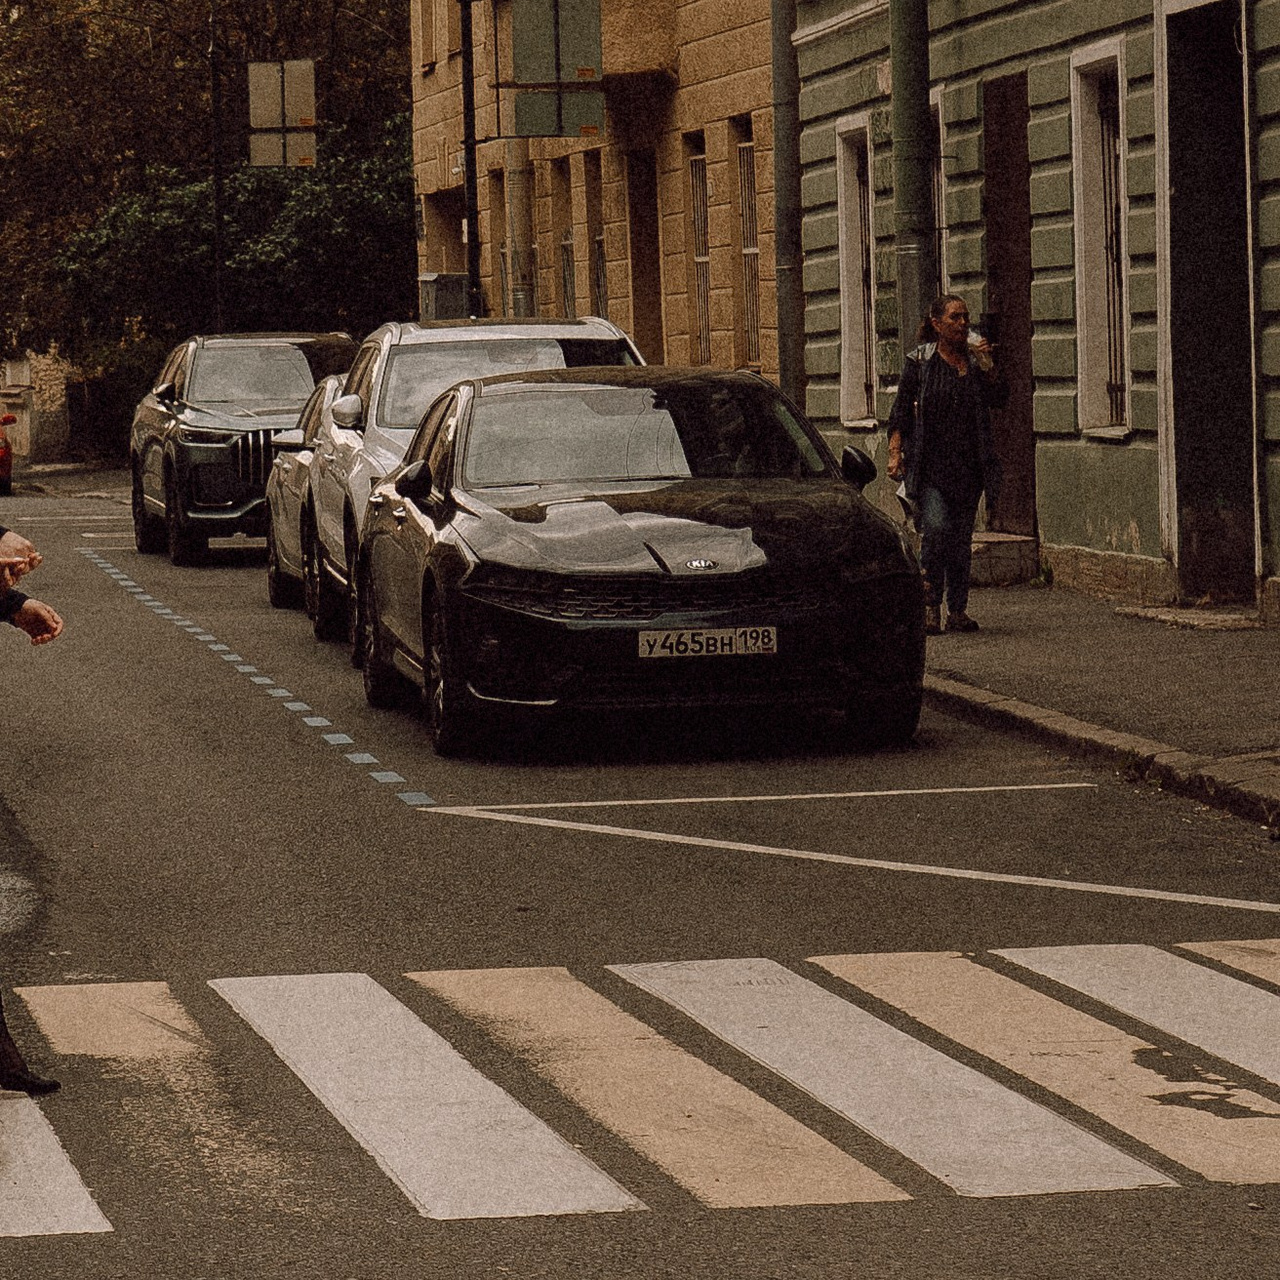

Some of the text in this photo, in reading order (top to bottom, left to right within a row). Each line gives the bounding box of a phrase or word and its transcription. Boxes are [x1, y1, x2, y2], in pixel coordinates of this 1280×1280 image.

[691, 559, 714, 568] KIA
[646, 629, 773, 655] У465ВН 198
